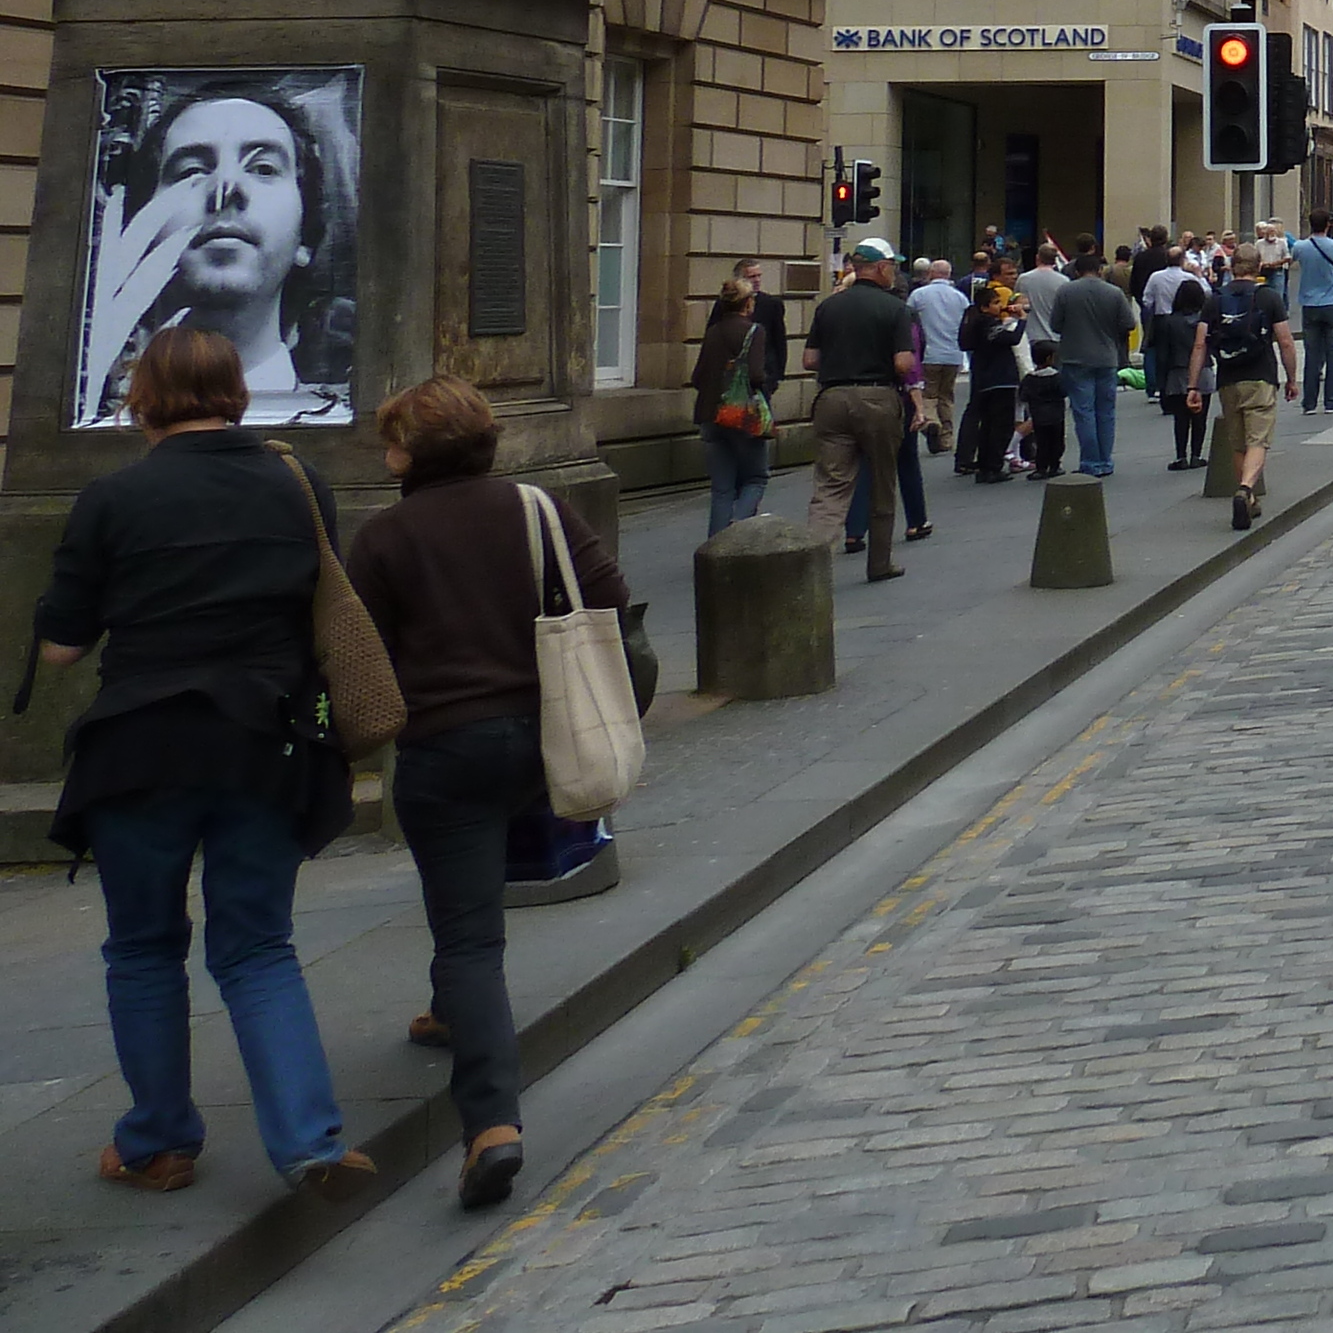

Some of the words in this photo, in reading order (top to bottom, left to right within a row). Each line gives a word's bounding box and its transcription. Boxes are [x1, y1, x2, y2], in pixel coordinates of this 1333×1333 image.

[866, 28, 933, 48] BANK
[939, 28, 971, 48] OF
[980, 27, 1106, 47] SCOTLAND
